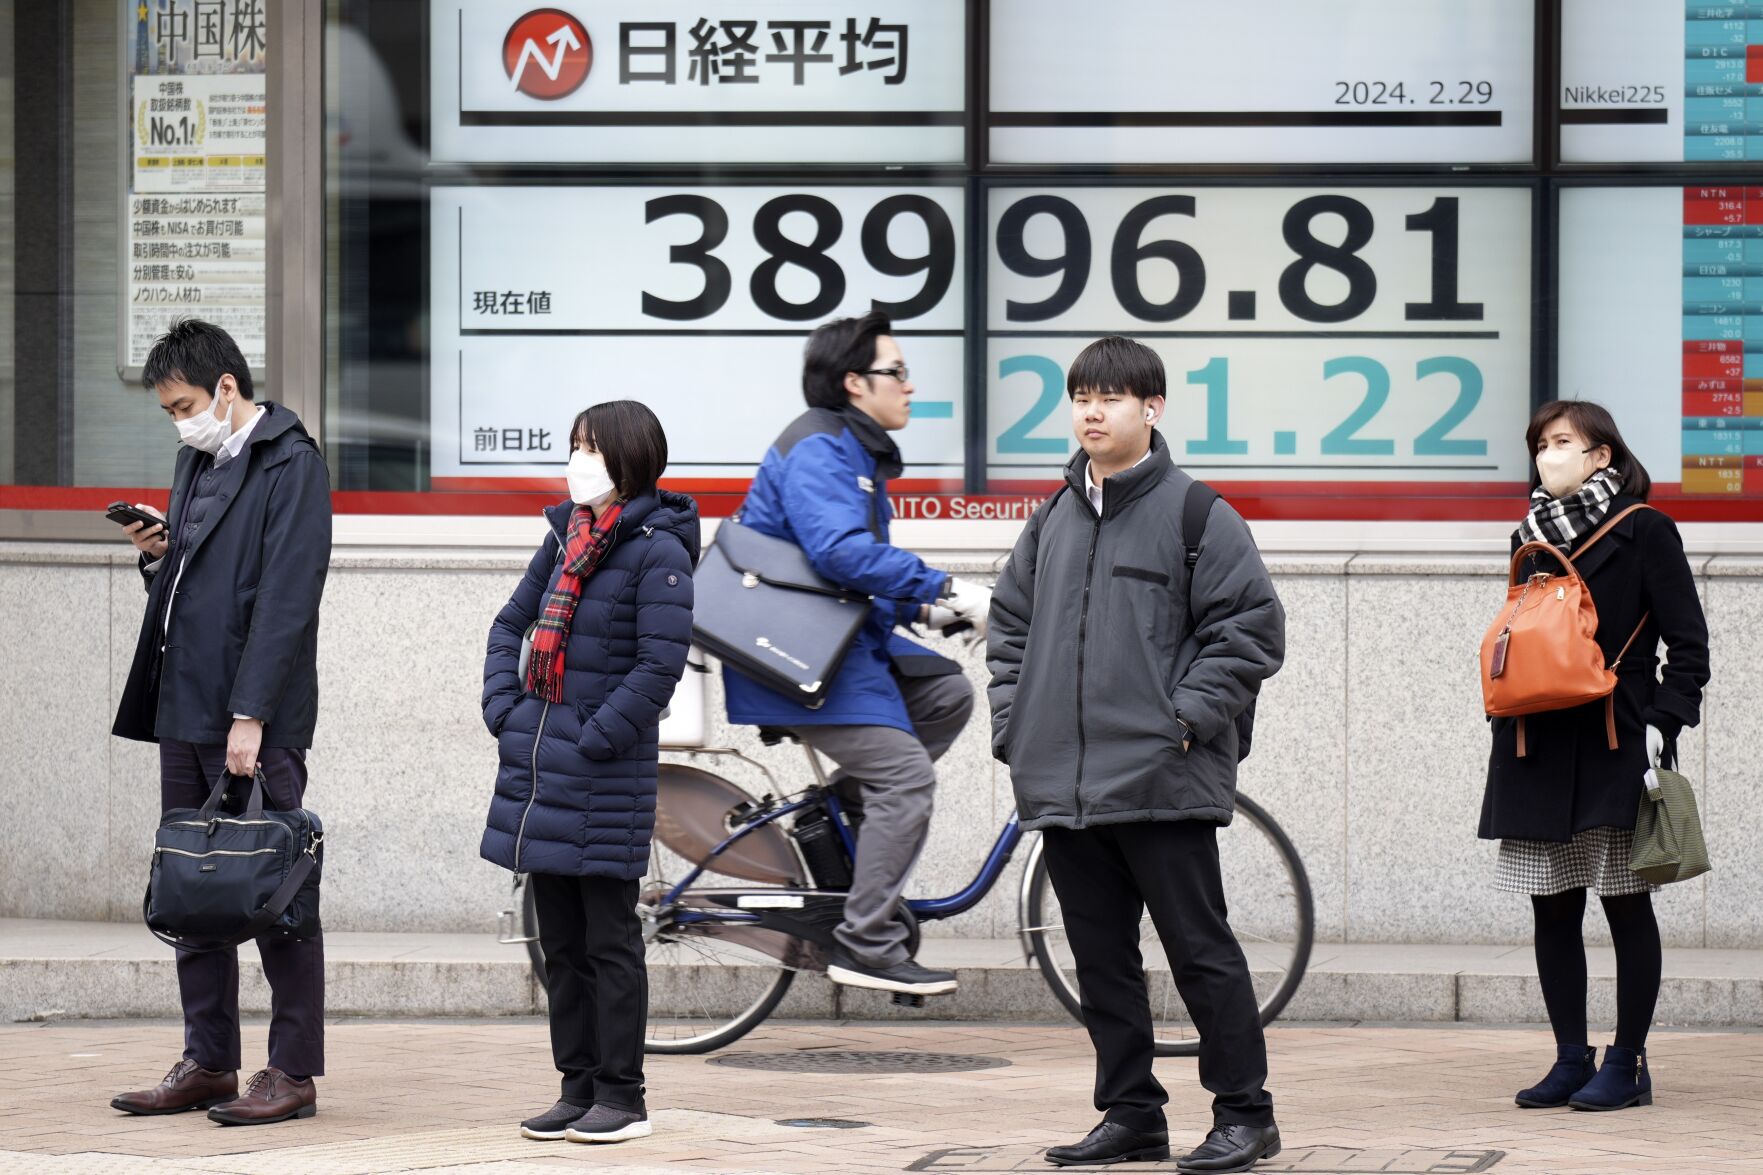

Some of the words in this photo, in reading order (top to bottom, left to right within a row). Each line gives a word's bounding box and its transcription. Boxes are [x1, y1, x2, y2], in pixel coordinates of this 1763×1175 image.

[157, 0, 266, 61] 中国株
[619, 17, 909, 86] 日経平均
[159, 82, 184, 95] 中国株
[1564, 85, 1665, 103] Nikkei225
[151, 116, 195, 145] No.1!
[1701, 189, 1726, 198] NTN
[1718, 202, 1742, 210] 316.4
[1696, 228, 1731, 237] シャープ
[134, 242, 231, 258] 取引時間中の注文が可能
[641, 194, 1484, 323] 38996.81
[134, 264, 195, 281] 分別管理で安心
[134, 286, 201, 303] ノウハウと人材力
[473, 290, 551, 317] 現在値
[1712, 394, 1740, 402] 2774.5
[474, 426, 551, 453] 前日比
[1699, 457, 1725, 466] NTT
[950, 497, 1046, 519] Securit
